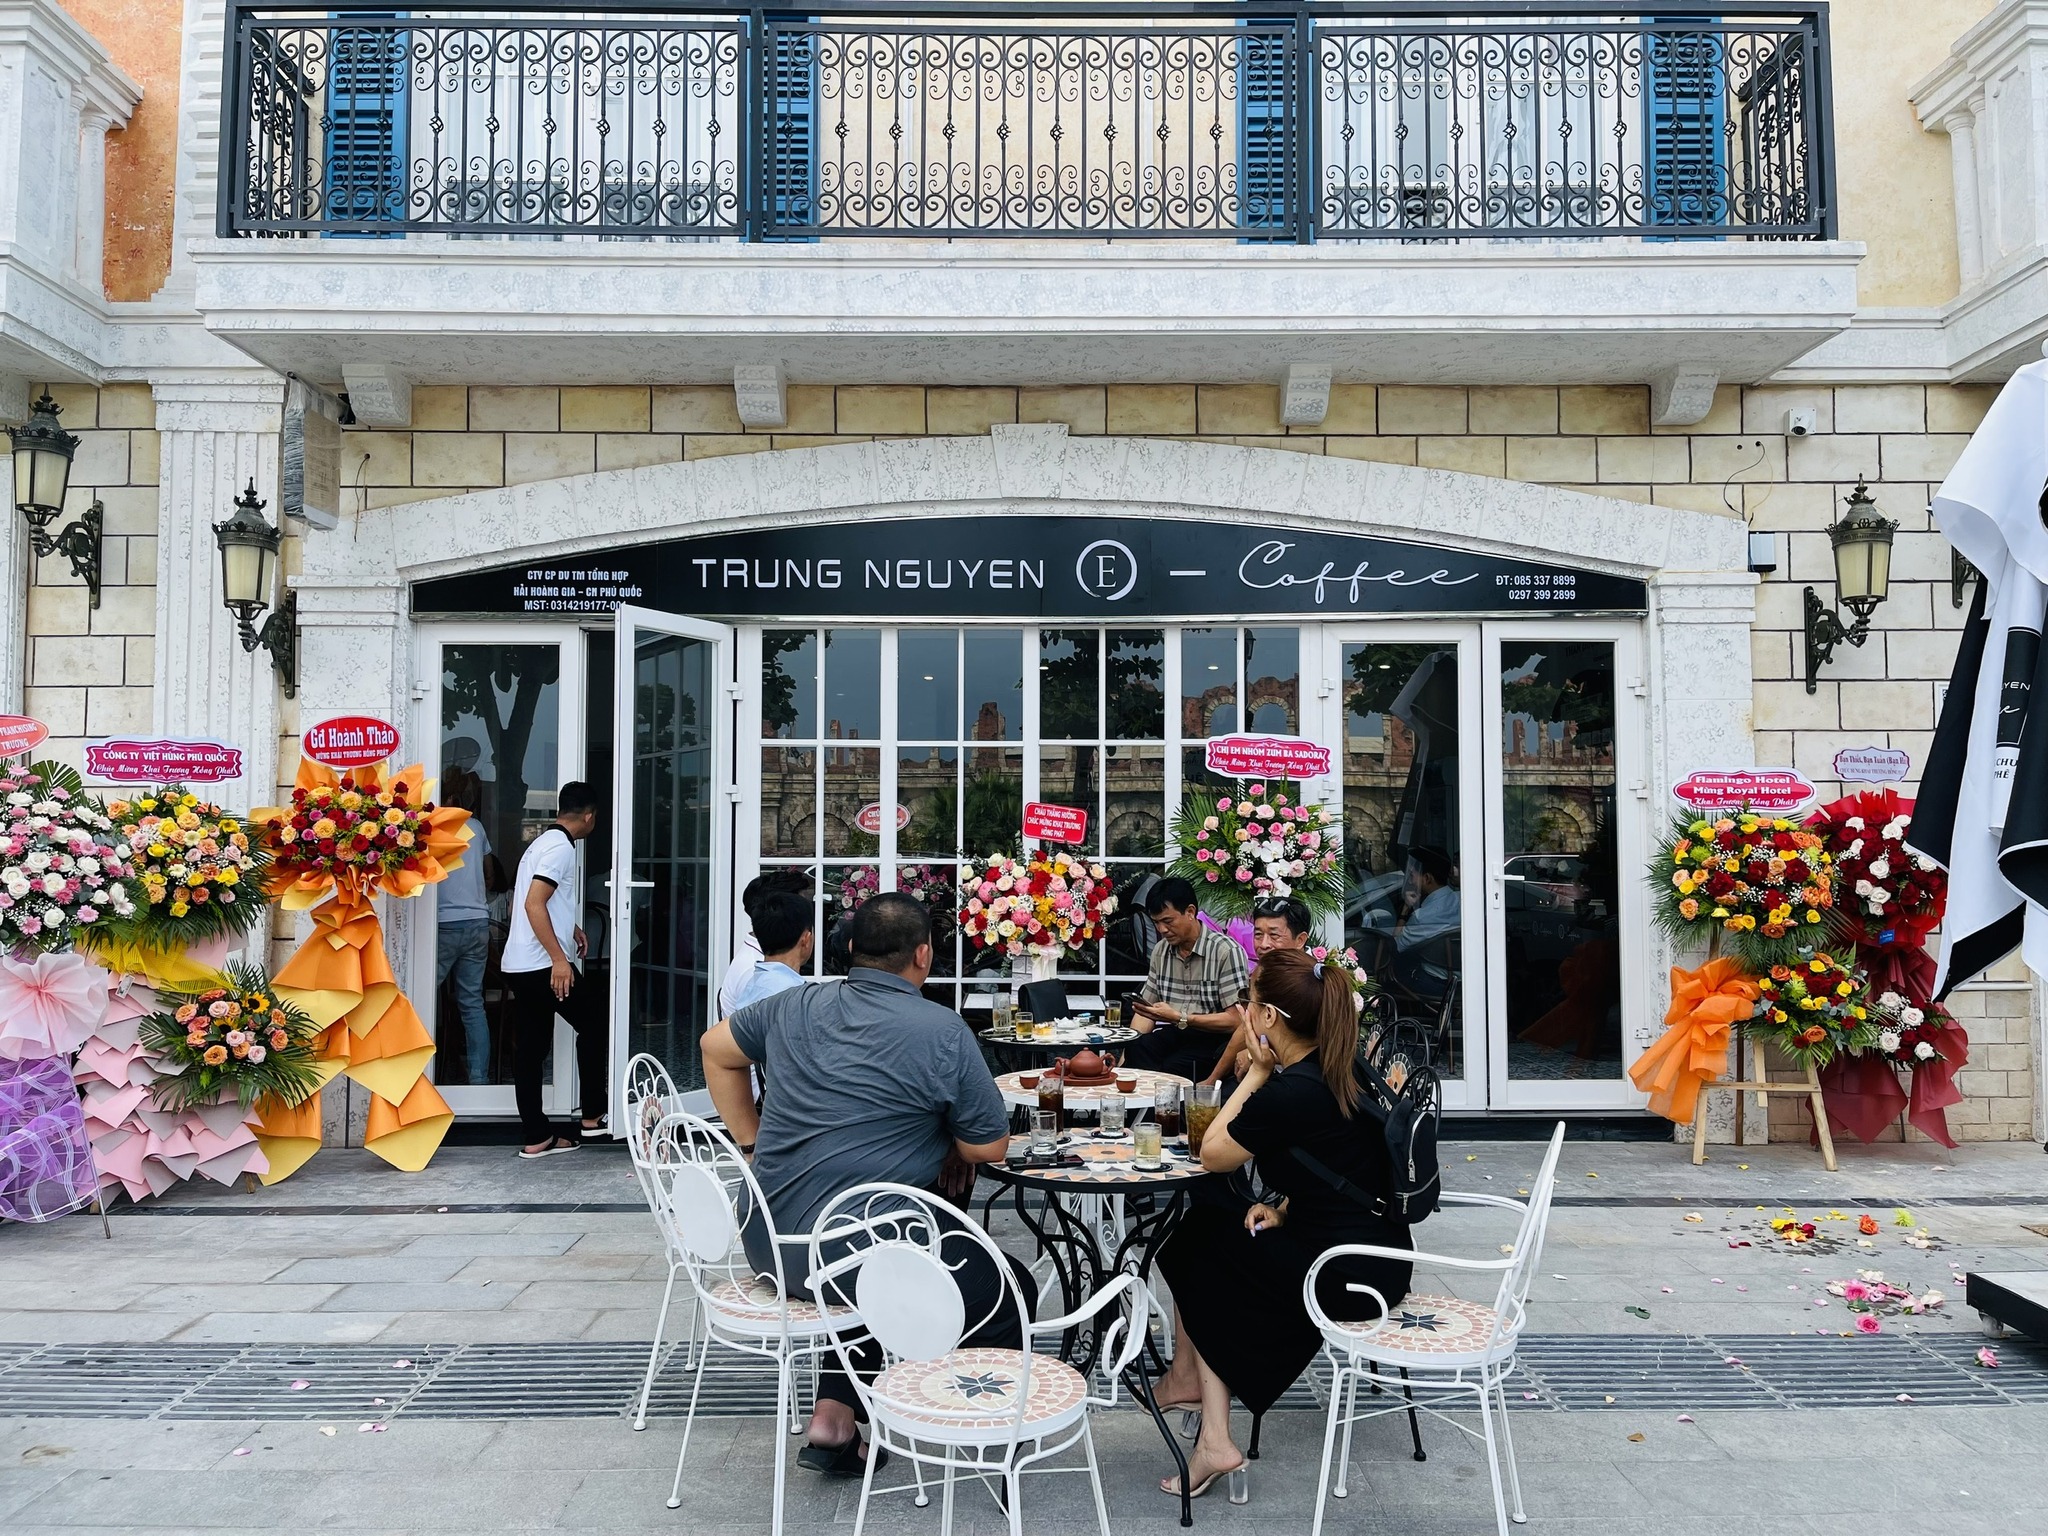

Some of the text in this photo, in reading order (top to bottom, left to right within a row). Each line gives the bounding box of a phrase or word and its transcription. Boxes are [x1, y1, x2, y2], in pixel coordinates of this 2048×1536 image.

[527, 570, 543, 580] CTY
[544, 570, 557, 580] CP
[558, 570, 570, 581] DV
[571, 570, 585, 581] TM
[692, 558, 842, 589] TRUNG
[865, 559, 1044, 589] NGUYEN
[1238, 540, 1480, 605] Coffee
[1495, 575, 1576, 586] ĐT: 085 337 8899
[530, 585, 559, 597] HOÀNG
[561, 587, 576, 597] GIA
[585, 587, 598, 597] CN
[618, 584, 642, 598] QUỐC
[1508, 589, 1576, 600] 0297 399 2899
[524, 600, 550, 611] MST:
[310, 725, 394, 749] Gđ Hoành Thảo
[102, 750, 128, 760] CÔNG
[129, 751, 140, 760] TY
[142, 751, 161, 762] VIỆT
[187, 751, 203, 761] PHÚ
[204, 752, 228, 763] QUỐC
[1230, 746, 1241, 755] EM
[1266, 748, 1282, 758] ZUM
[1283, 749, 1294, 758] BA
[1294, 750, 1325, 760] SADORA
[116, 764, 139, 775] Mừng
[140, 764, 161, 773] Khai
[162, 764, 190, 775] Trương
[1695, 775, 1791, 785] Flamingo Hotel
[1693, 786, 1791, 796] Mừng Royal Hotel
[1694, 797, 1714, 805] Khai
